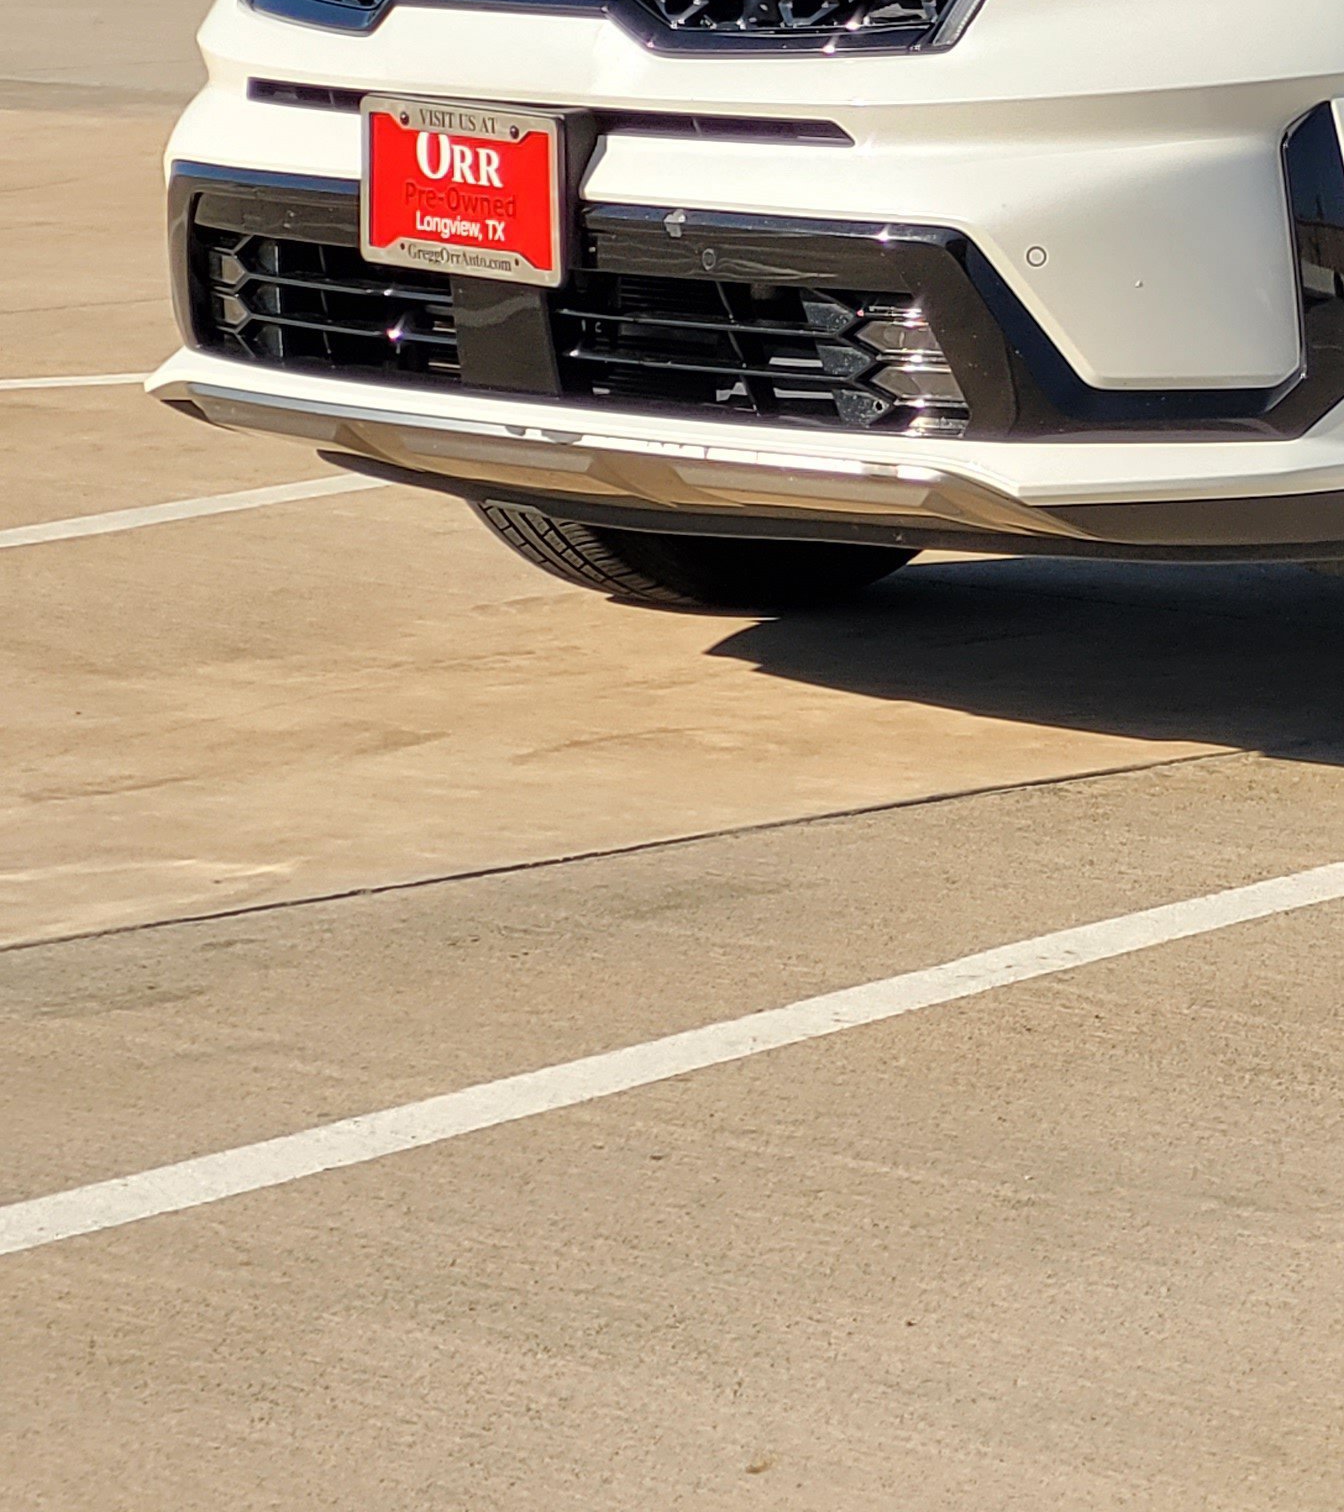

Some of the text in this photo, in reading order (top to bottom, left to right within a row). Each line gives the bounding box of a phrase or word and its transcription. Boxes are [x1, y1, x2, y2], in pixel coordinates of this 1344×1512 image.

[419, 108, 498, 135] VISIT US AT
[405, 181, 517, 218] Pre-Owned
[416, 210, 505, 242] Longview, TX
[408, 243, 512, 272] GreggOrrAuto.com
